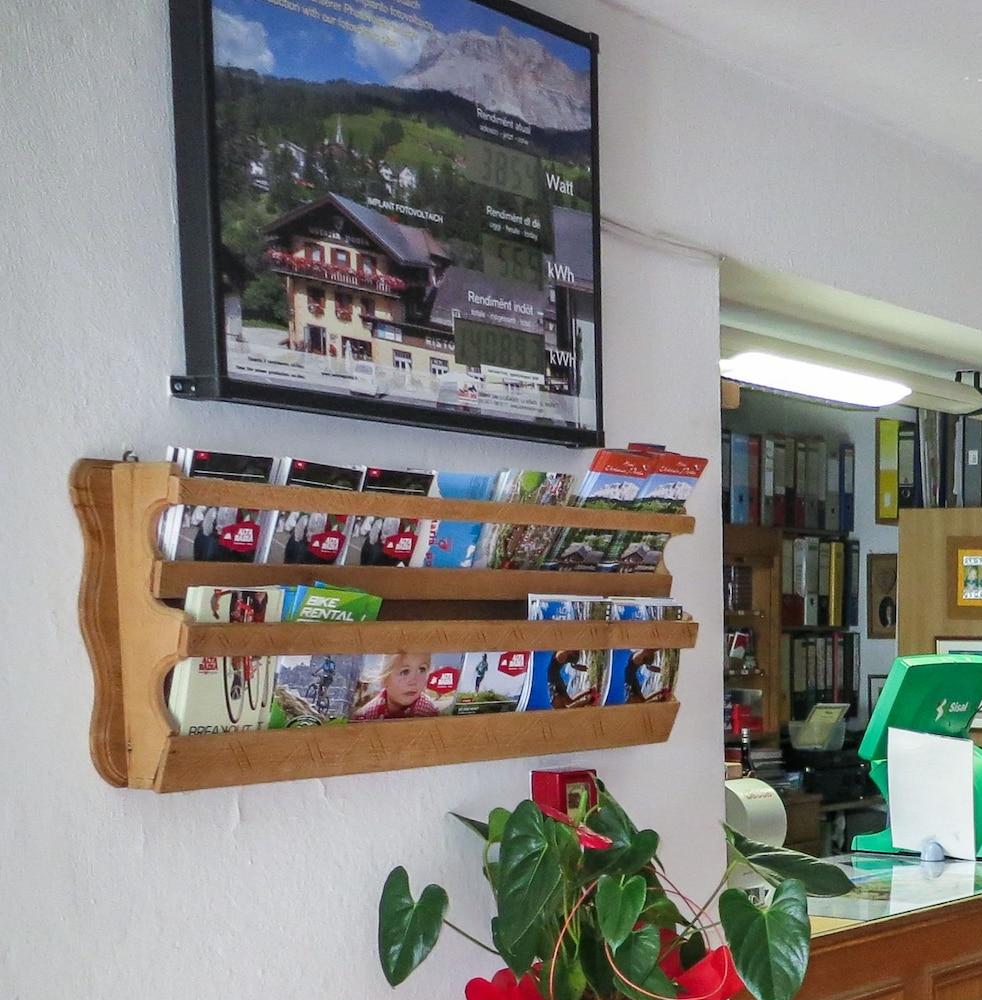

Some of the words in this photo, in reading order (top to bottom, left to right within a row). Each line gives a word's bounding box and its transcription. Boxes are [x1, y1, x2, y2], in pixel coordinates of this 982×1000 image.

[546, 172, 574, 196] Watt
[547, 260, 575, 283] kWh
[305, 595, 340, 608] BIKE
[300, 606, 354, 622] RENTAL
[948, 701, 969, 713] Sisal
